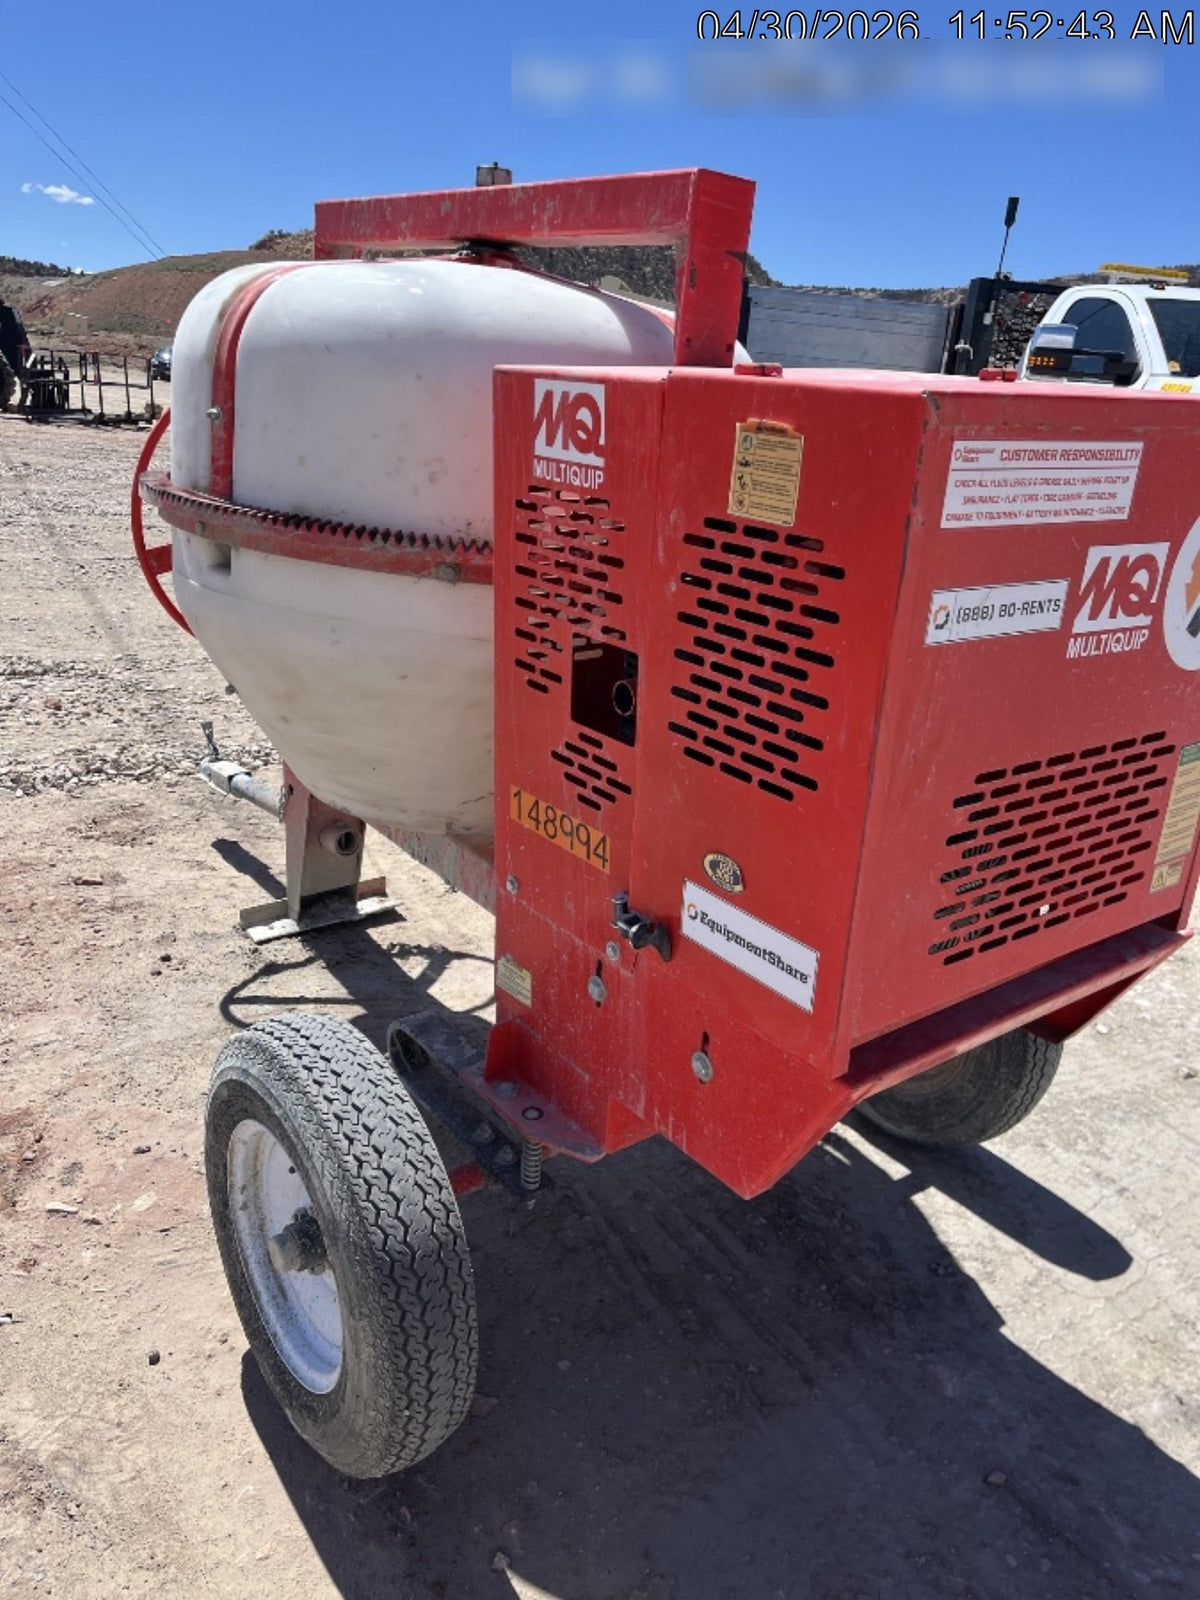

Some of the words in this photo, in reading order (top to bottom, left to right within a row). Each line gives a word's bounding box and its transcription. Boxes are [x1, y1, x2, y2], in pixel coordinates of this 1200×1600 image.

[533, 388, 606, 459] MQ
[533, 458, 604, 490] MULTIQUIP
[1000, 449, 1057, 462] CUSTOMER
[1059, 448, 1141, 462] RESPONSIBILITY
[1074, 551, 1162, 624] MQ
[956, 604, 995, 624] (888)
[1066, 629, 1149, 659] MULTIQUIP
[513, 789, 609, 870] 148994
[700, 909, 809, 984] EquipmentShare
